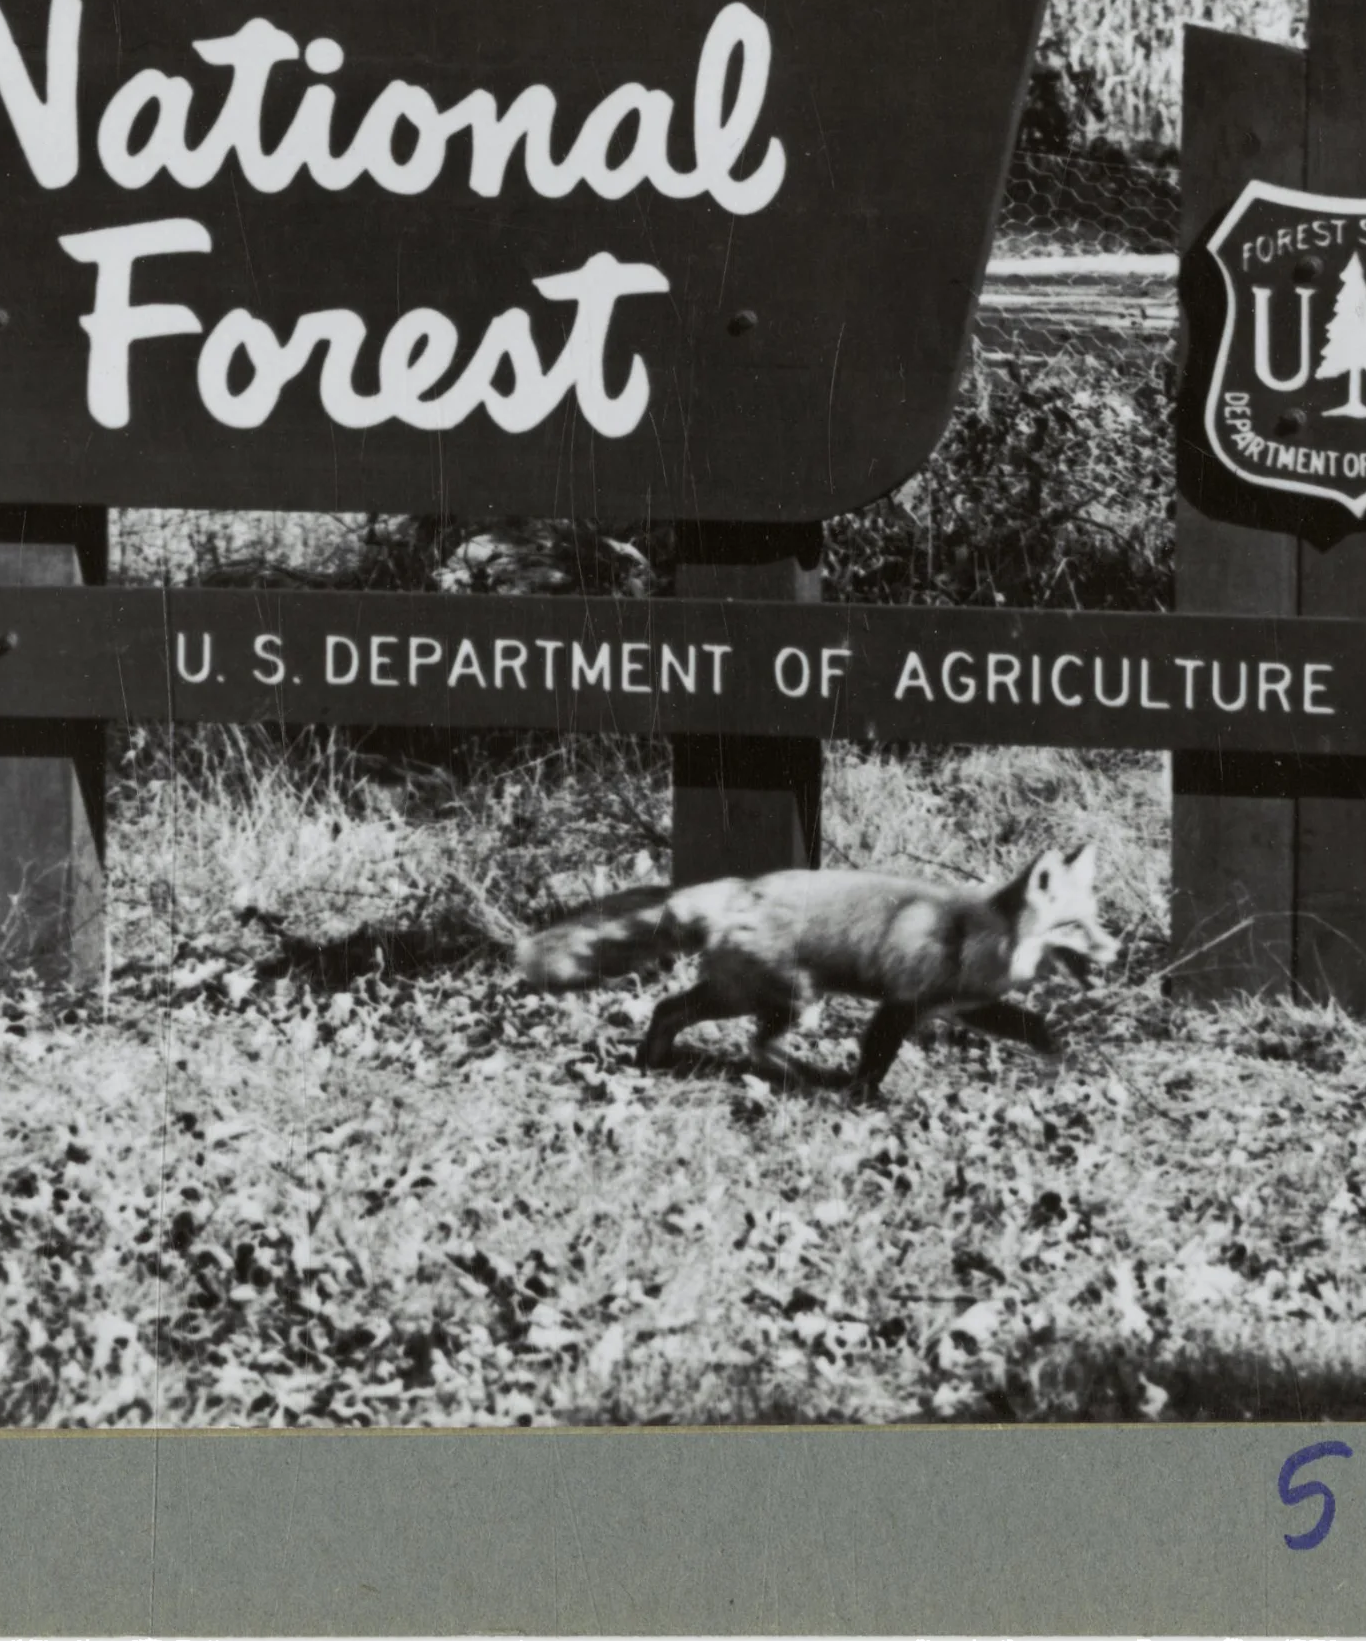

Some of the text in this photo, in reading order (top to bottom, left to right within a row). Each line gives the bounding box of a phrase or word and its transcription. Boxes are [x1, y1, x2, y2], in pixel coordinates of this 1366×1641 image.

[1242, 219, 1347, 272] FOREST
[58, 218, 669, 438] Forest
[1252, 286, 1318, 392] U
[1224, 392, 1339, 477] DEPARTMENT
[175, 632, 1334, 714] U. S. DEPARTMENT OF AGRICULTURE
